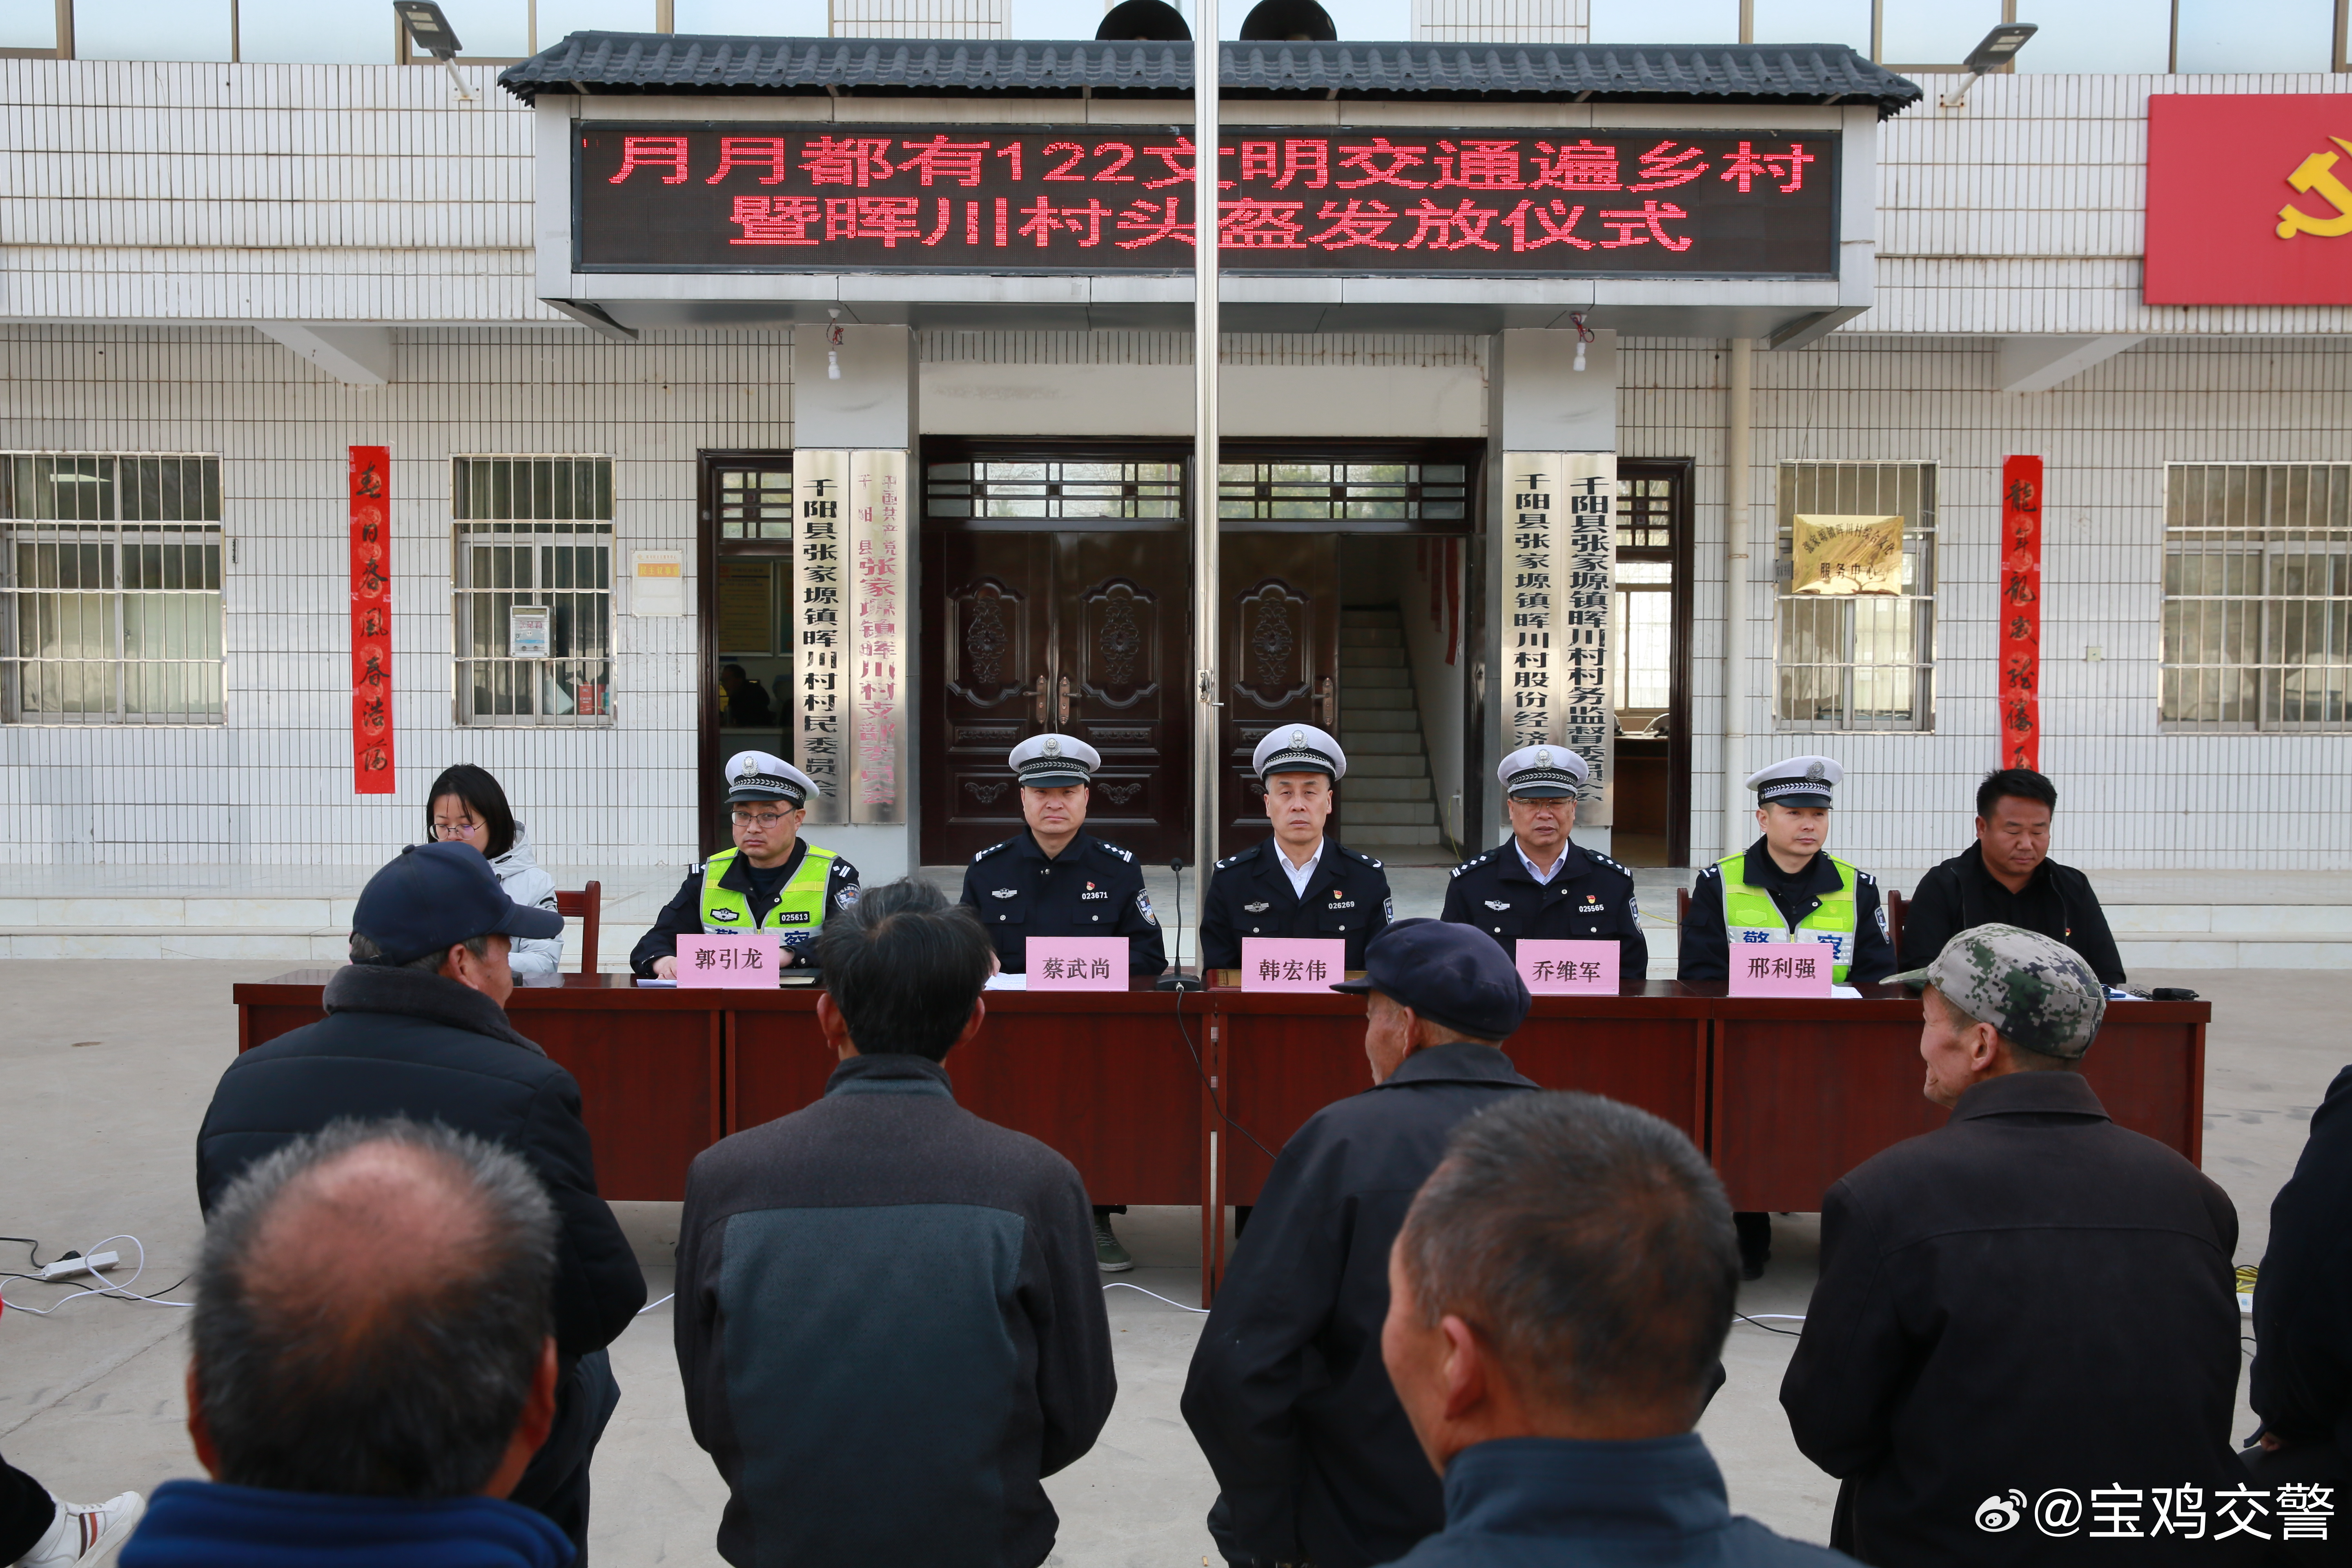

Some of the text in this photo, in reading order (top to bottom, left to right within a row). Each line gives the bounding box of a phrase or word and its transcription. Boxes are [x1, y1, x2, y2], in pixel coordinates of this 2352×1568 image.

[608, 134, 1815, 194] 月月都有122文明交通遍乡村
[729, 195, 1694, 252] 暨晖川村头盔发放仪式
[858, 474, 873, 555] 千阳县
[882, 474, 898, 556] 中国共产党
[1820, 562, 1876, 580] 服务中心
[802, 479, 839, 797] 千阳县张家塬镇晖川村村民委员会
[1082, 891, 1108, 900] 023671
[1328, 901, 1355, 909] 026269
[782, 913, 808, 922] 025613
[1579, 904, 1604, 912] 025565
[695, 948, 763, 970] 郭引龙
[1042, 957, 1110, 980] 蔡武尚
[1258, 959, 1327, 981] 韩宏伟
[1747, 957, 1815, 979] 邢利强
[1532, 960, 1601, 983] 乔维军
